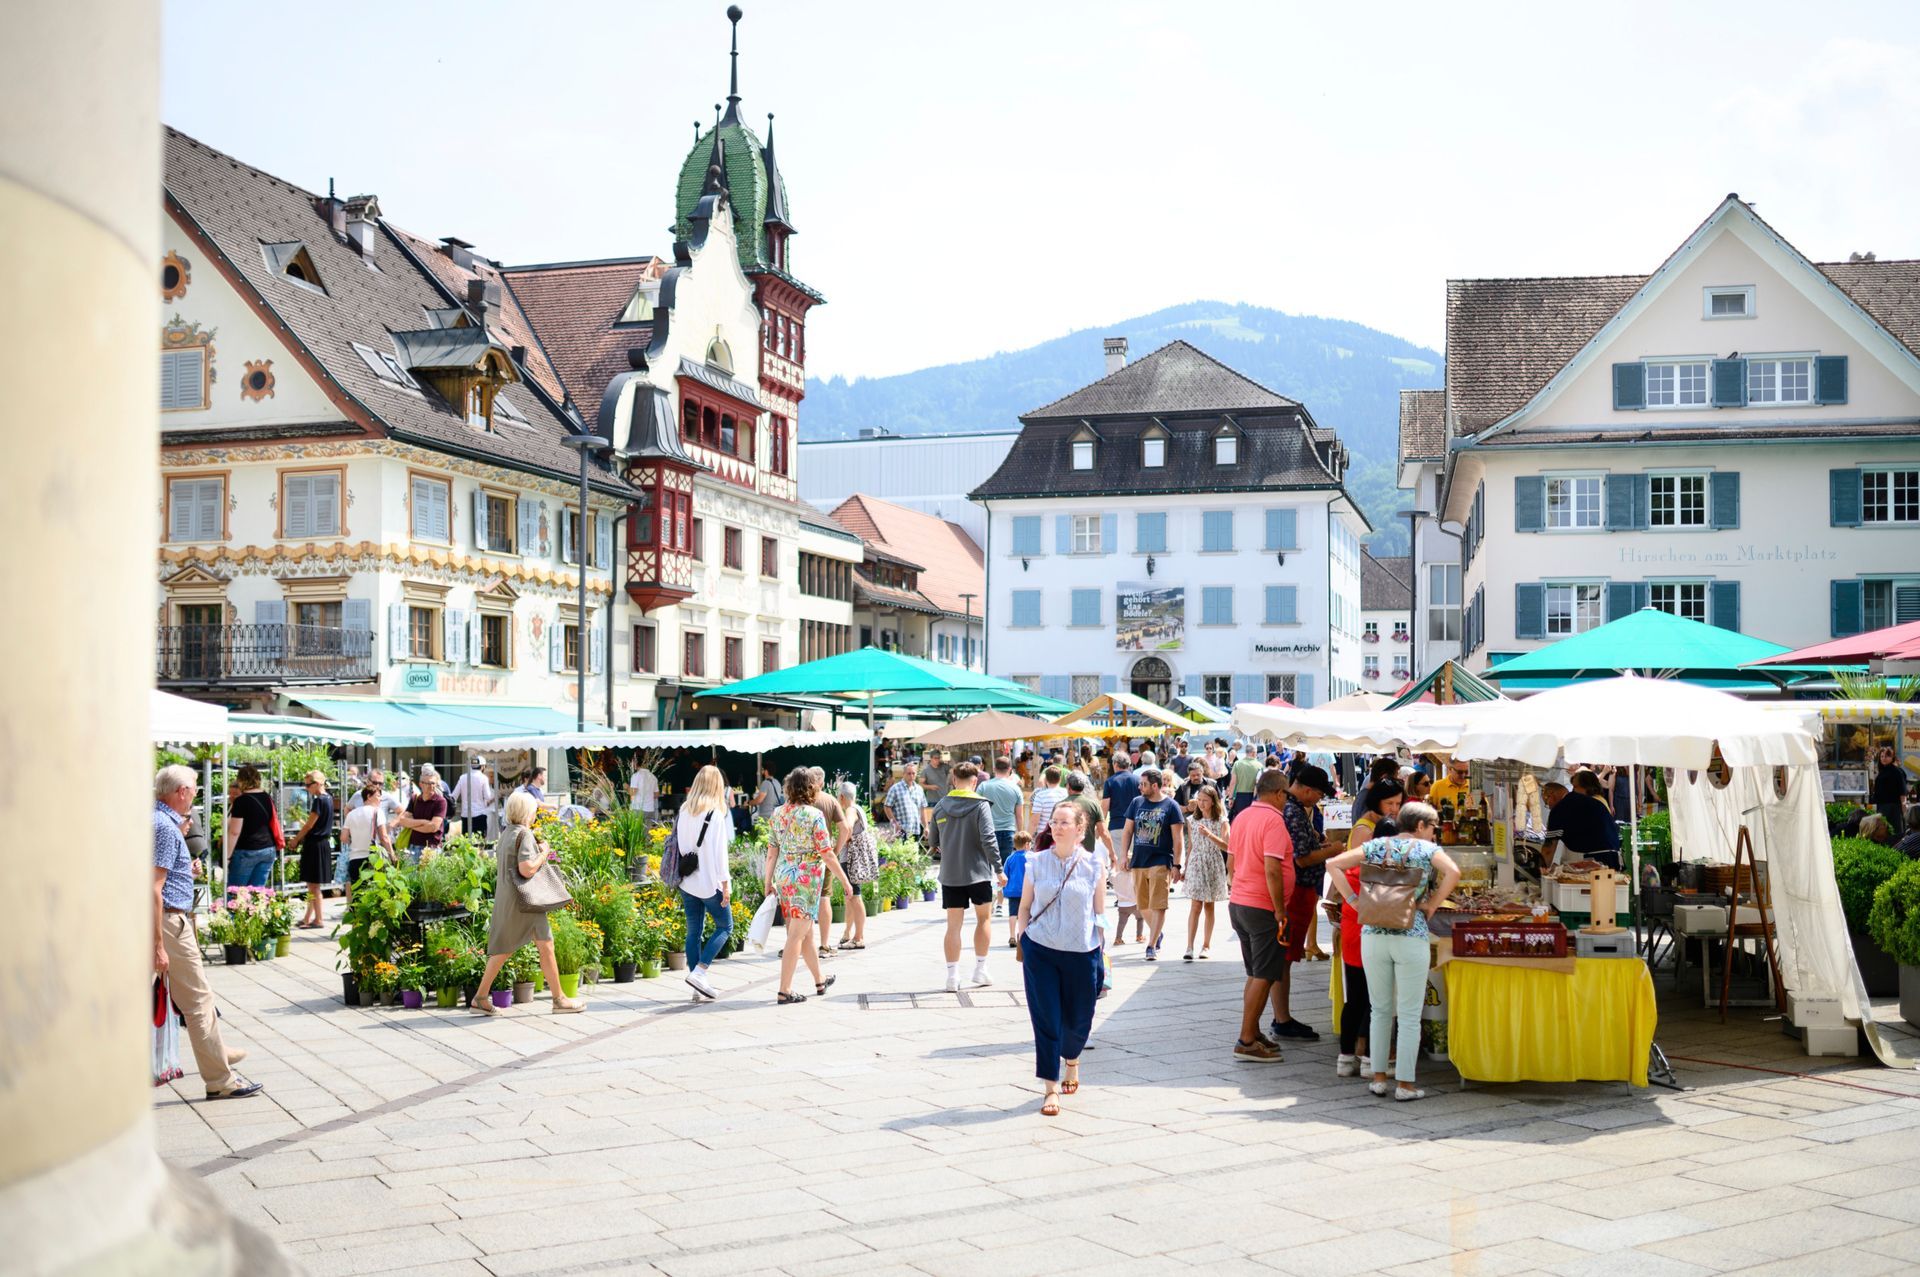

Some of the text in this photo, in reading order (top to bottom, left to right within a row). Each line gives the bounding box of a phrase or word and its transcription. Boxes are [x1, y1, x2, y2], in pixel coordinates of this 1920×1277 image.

[1618, 544, 1839, 563] Hirschen am Marktplatz
[1123, 595, 1151, 605] gehört
[1127, 602, 1142, 610] das
[1255, 644, 1321, 653] Museum Archiv
